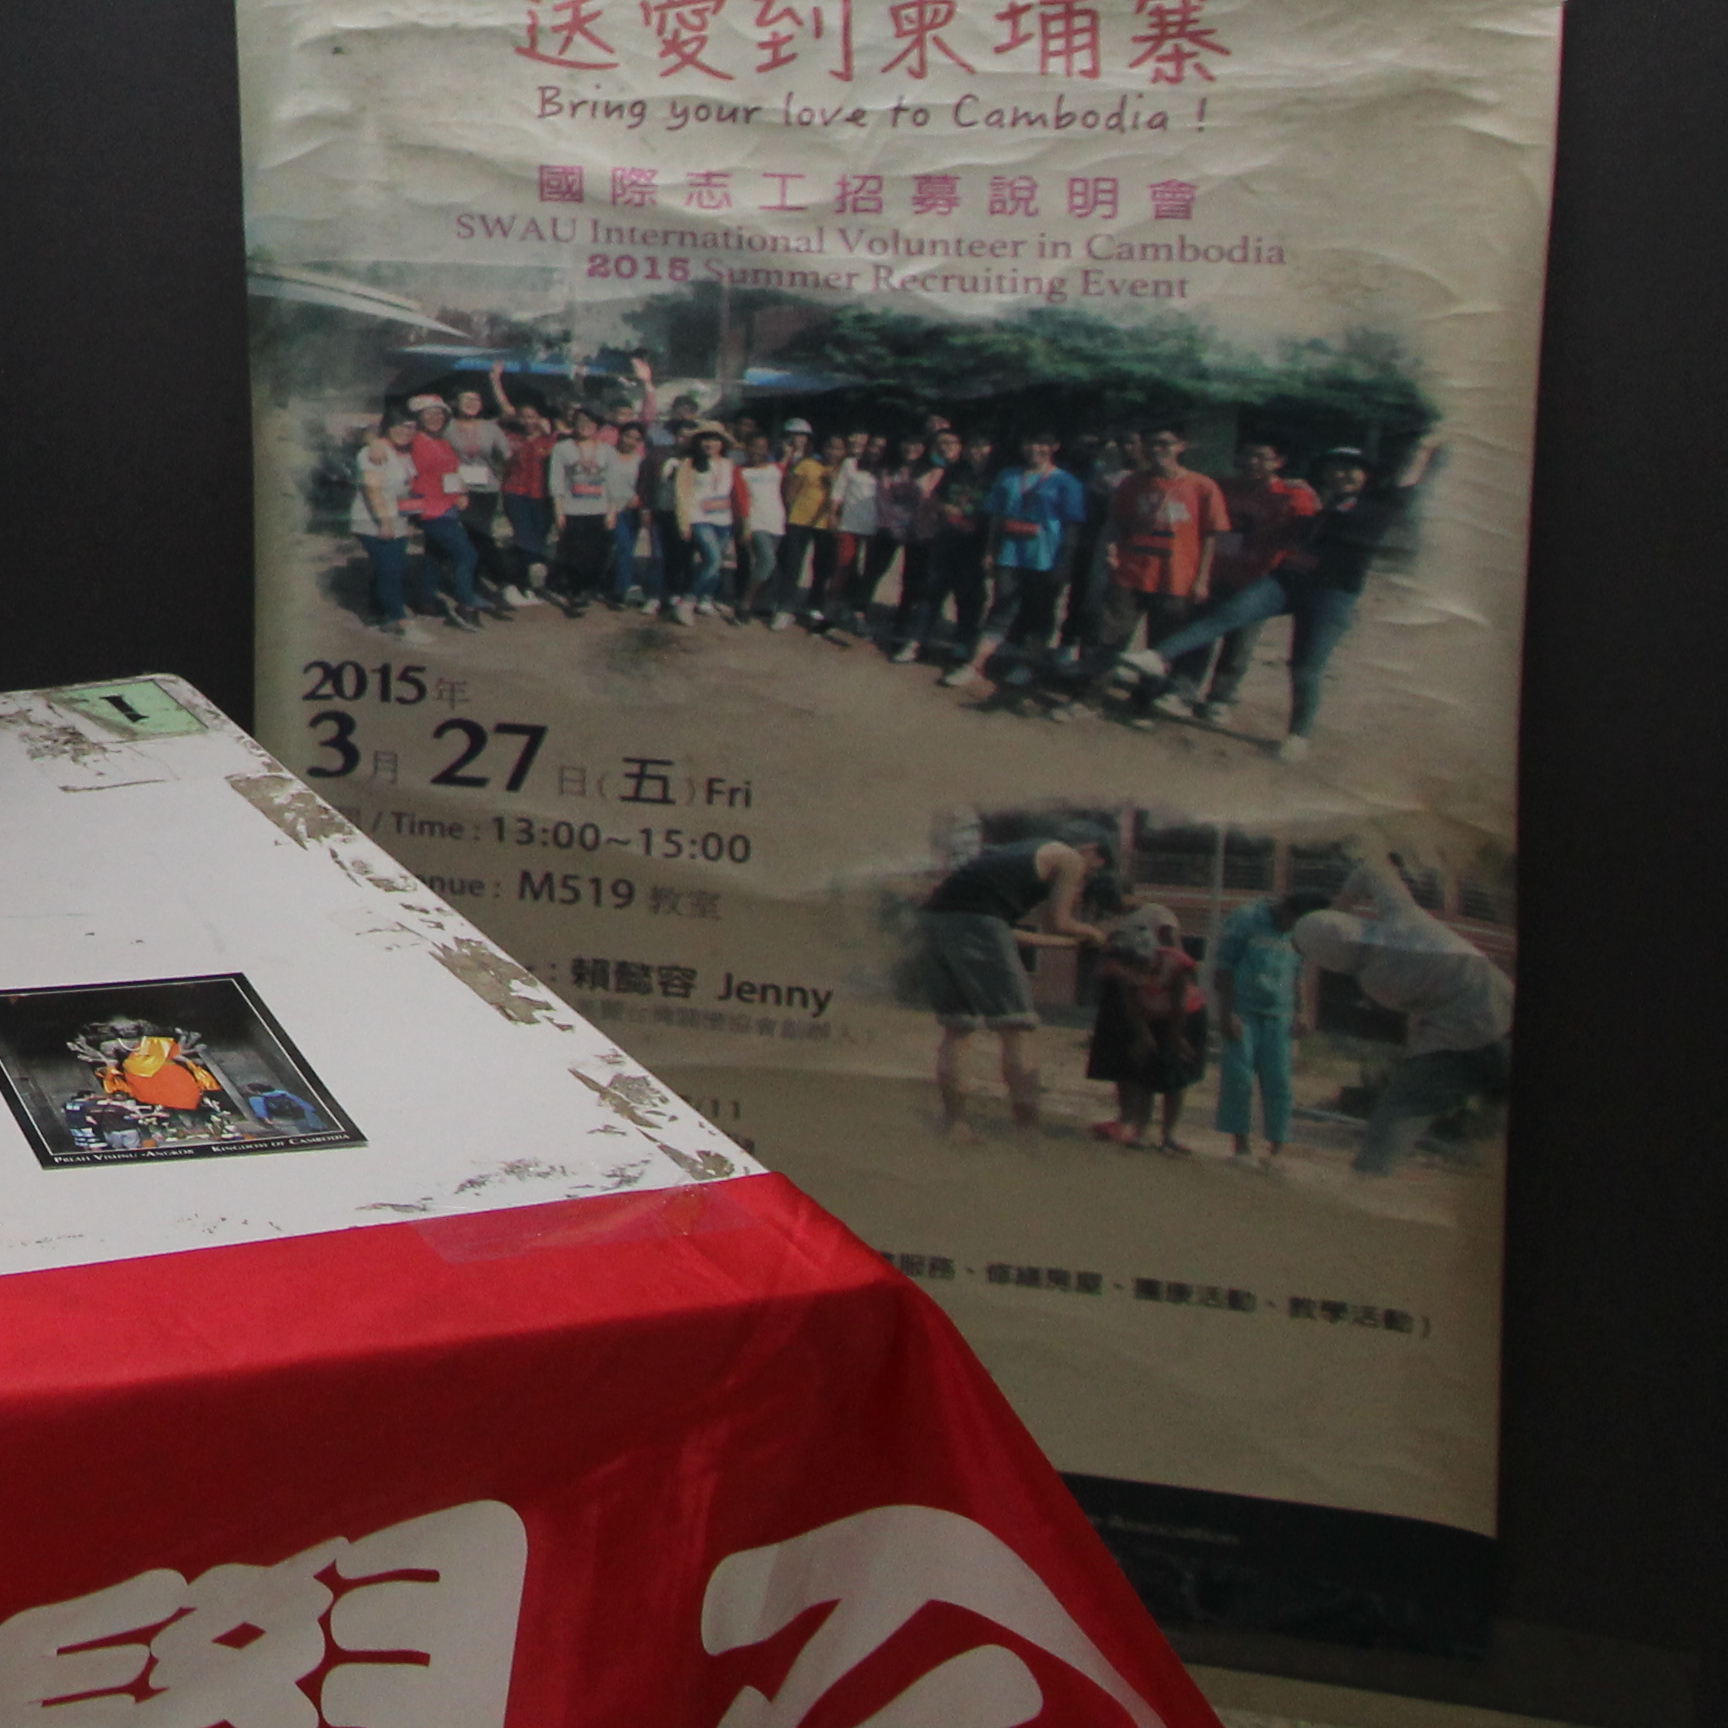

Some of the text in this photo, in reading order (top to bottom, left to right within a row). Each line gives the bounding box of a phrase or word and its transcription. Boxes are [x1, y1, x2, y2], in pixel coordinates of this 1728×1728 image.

[537, 83, 647, 129] Bring
[666, 105, 762, 132] your
[783, 90, 867, 128] love
[890, 94, 931, 128] to
[953, 92, 1169, 134] Cambodia
[539, 165, 1199, 221] 國際志工招募說明會
[455, 212, 1287, 266] SWAU International Volunteer in Cambodia
[587, 253, 1190, 304] 2015 Summer Recruiting Event
[706, 777, 753, 809] Fri
[517, 870, 636, 911] M519
[717, 973, 835, 1018] Jenny
